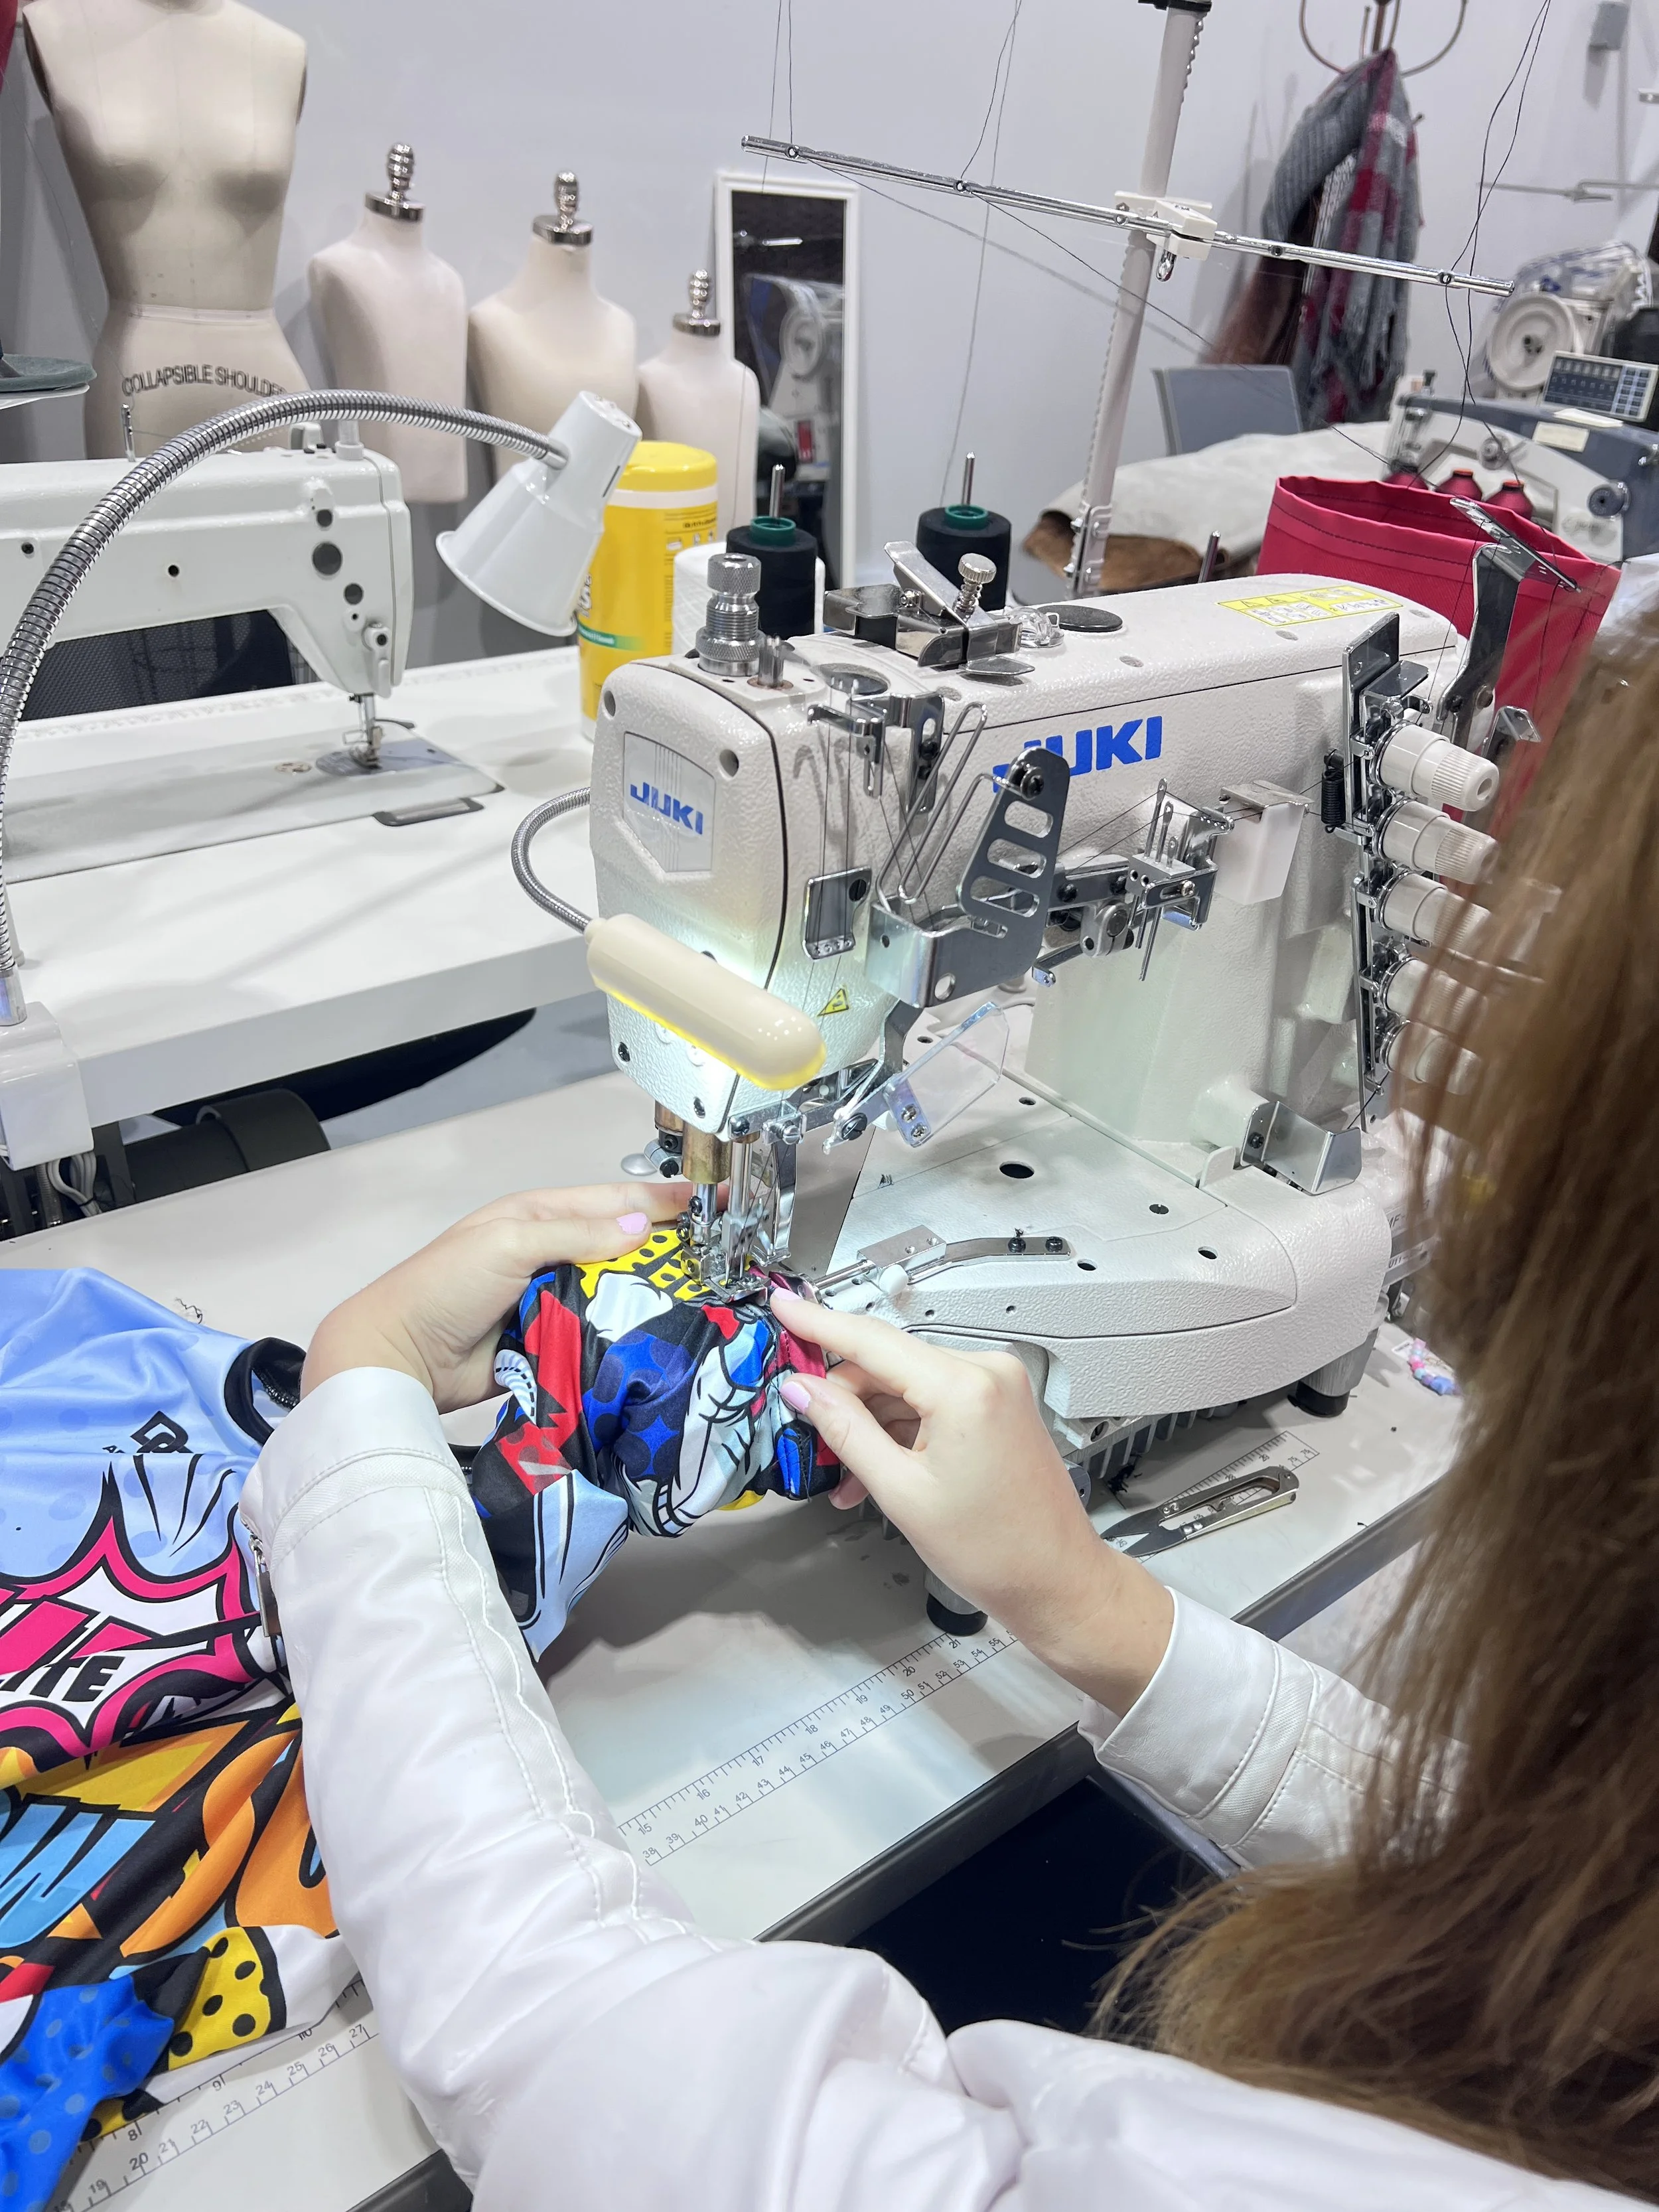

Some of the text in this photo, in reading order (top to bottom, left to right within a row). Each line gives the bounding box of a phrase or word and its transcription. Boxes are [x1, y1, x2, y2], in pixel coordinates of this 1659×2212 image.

[121, 364, 214, 397] COLLAPSIBLE
[993, 715, 1163, 793] UKI
[630, 782, 703, 835] JUKI
[638, 1639, 961, 1835] 15 16 17 18 19 20 21
[642, 1847, 656, 1859] 38
[666, 1833, 679, 1844] 39
[695, 1814, 708, 1826] 40
[714, 1805, 725, 1815] 41
[735, 1792, 747, 1803] 42
[757, 1779, 769, 1789] 43
[778, 1765, 790, 1775] 44
[800, 1753, 811, 1763] 45
[820, 1741, 831, 1751] 46
[840, 1728, 851, 1738] 47
[860, 1716, 871, 1726] 48
[880, 1704, 890, 1714] 49
[901, 1689, 914, 1700] 50
[917, 1680, 928, 1691] 51
[935, 1670, 946, 1680] 52
[953, 1659, 964, 1669] 53
[971, 1649, 982, 1658] 54
[988, 1637, 999, 1647] 55
[89, 2177, 106, 2194] 19
[129, 2152, 149, 2171] 20
[159, 2138, 175, 2154] 21
[190, 2119, 207, 2134] 22
[223, 2100, 240, 2114] 23
[255, 2081, 272, 2096] 24
[287, 2061, 303, 2076] 25
[318, 2043, 334, 2057] 26
[348, 2024, 364, 2038] 27
[128, 2129, 138, 2141] 8
[212, 2080, 222, 2091] 9
